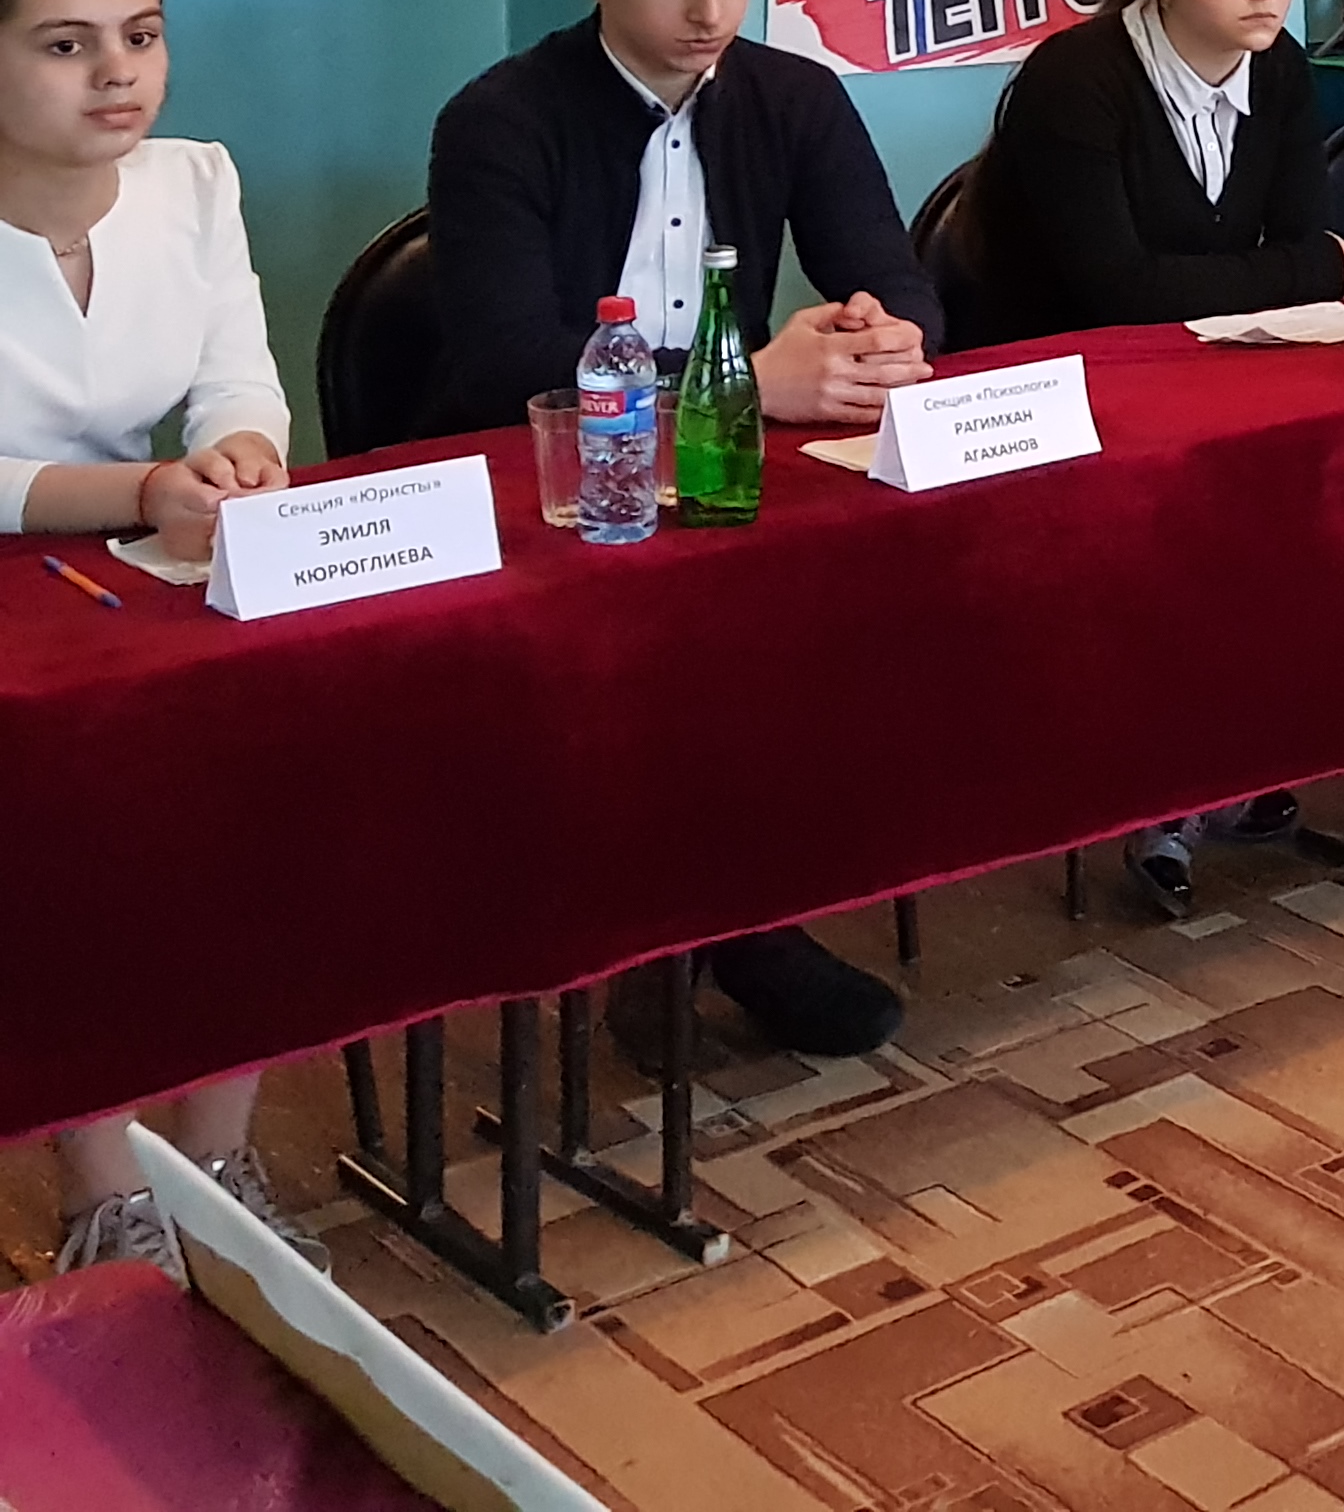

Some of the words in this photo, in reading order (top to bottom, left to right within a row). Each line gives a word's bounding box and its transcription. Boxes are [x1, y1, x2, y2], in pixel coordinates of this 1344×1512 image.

[923, 394, 972, 411] Секция
[976, 379, 1059, 401] «Психологи»
[954, 409, 1034, 435] РАГИМХАН
[963, 438, 1039, 463] АГАХАНОВ
[278, 495, 344, 518] Секция
[350, 479, 442, 503] «Юристы»
[318, 518, 392, 547] ЭМИЛЯ
[294, 546, 434, 587] КЮРЮГЛИЕВА
